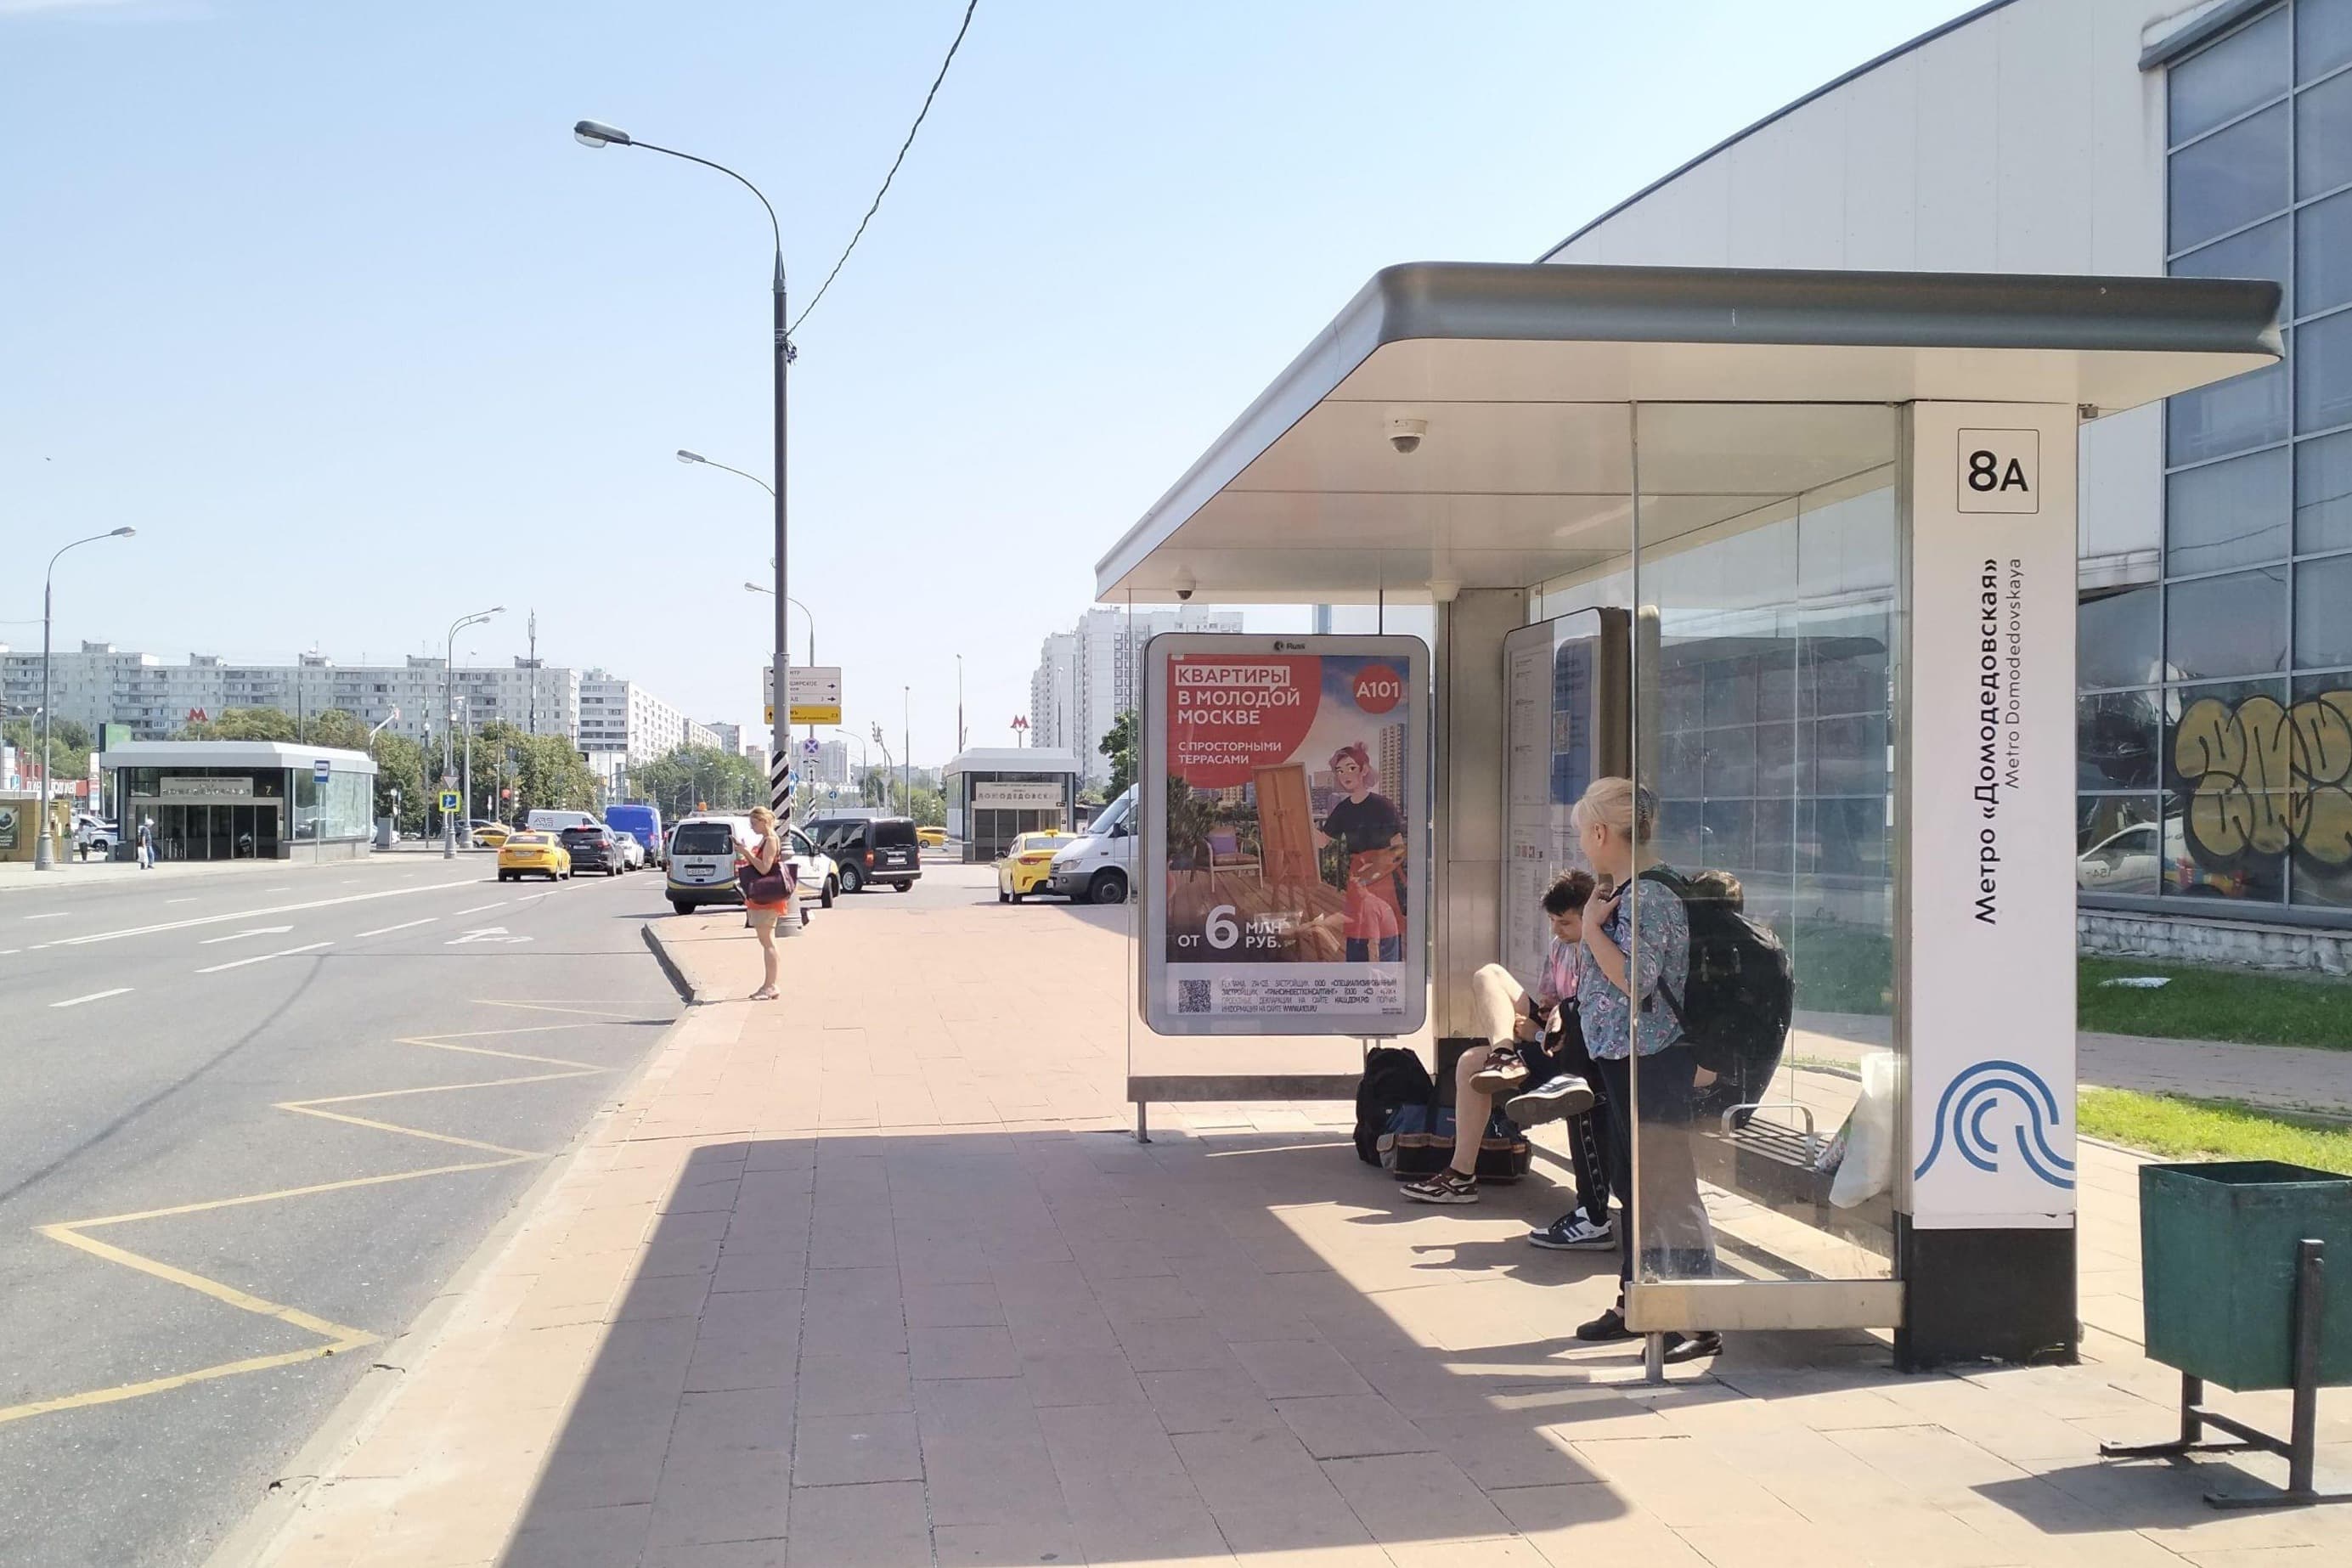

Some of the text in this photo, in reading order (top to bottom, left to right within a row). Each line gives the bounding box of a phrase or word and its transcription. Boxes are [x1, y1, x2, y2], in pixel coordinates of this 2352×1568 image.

[1968, 449, 2029, 492] 8А
[1178, 668, 1287, 683] КВАРТИРЫ
[2005, 558, 2025, 789] Metro Domodedovskaya
[1178, 687, 1300, 708] В МОЛОДОЙ
[1356, 681, 1400, 698] А101
[1178, 709, 1261, 725] МОСКВЕ
[1178, 742, 1282, 752] С ПРОСТОРНЫМИ
[1974, 558, 2000, 925] Метро «Домодедовская»
[1178, 755, 1249, 764] ТЕРРАСАМИ
[1177, 905, 1239, 950] ОТ 6
[1246, 922, 1283, 934] МЛН
[1246, 936, 1282, 950] РУБ.
